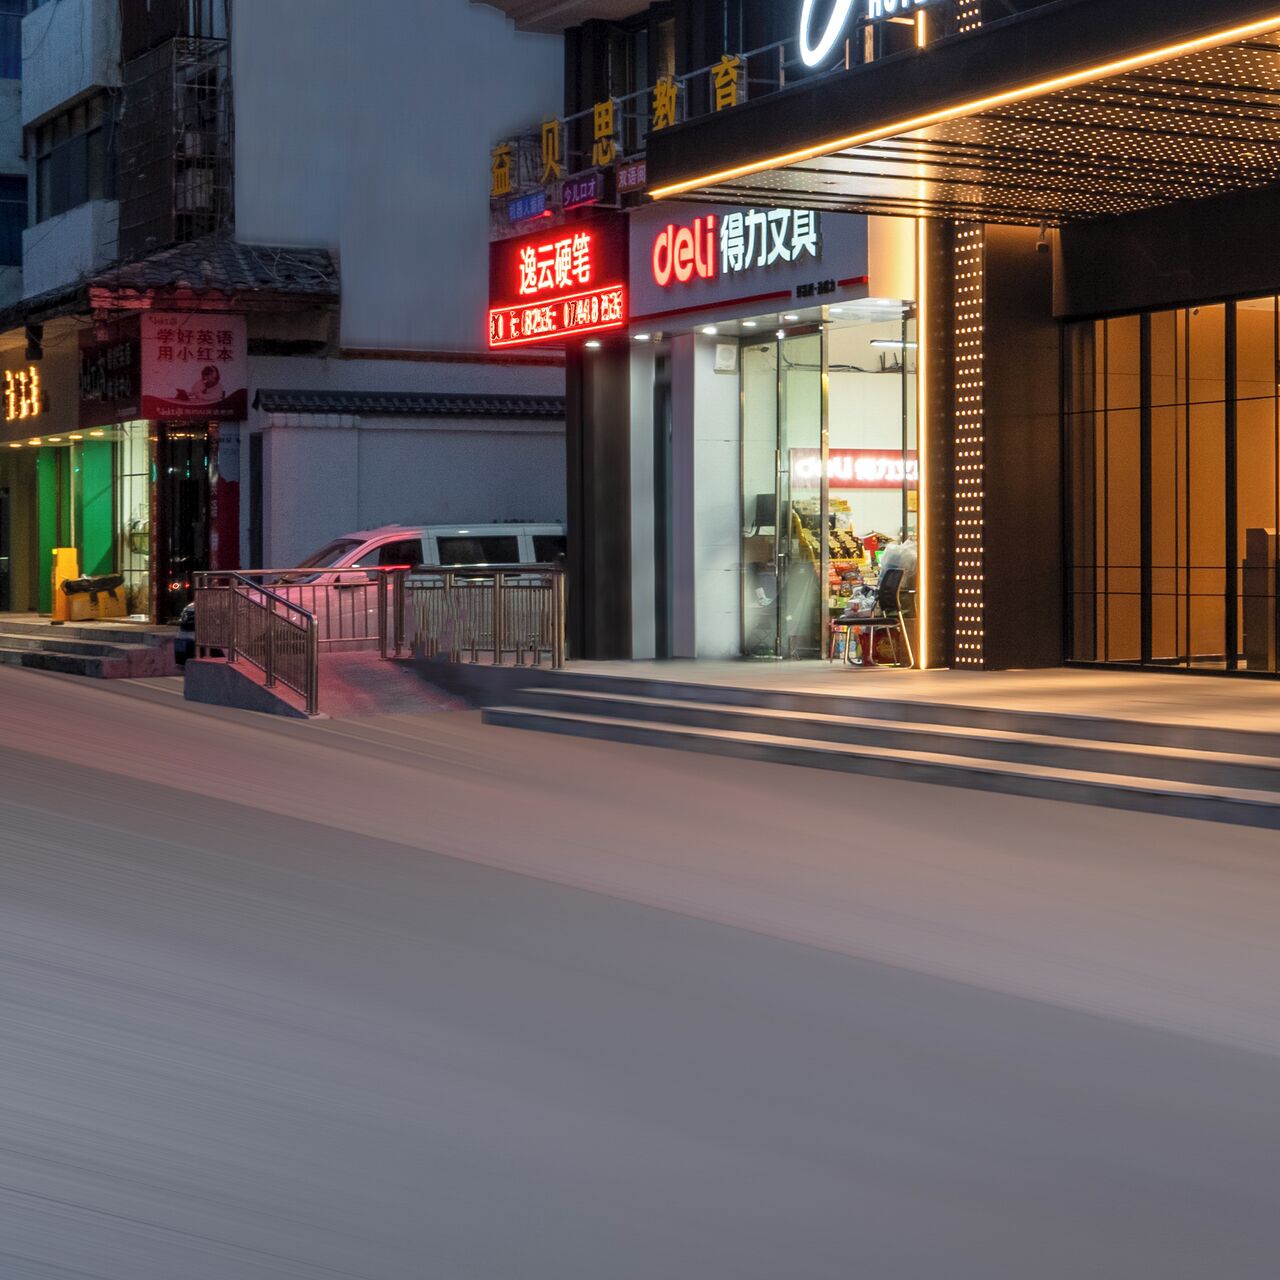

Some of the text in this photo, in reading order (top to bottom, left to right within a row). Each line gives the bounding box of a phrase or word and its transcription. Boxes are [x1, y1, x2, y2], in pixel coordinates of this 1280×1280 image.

[489, 54, 742, 197] 益贝思教育
[564, 179, 597, 205] 少儿口才
[519, 232, 591, 295] 逸云硬笔
[653, 214, 716, 287] deli
[720, 208, 818, 274] 得力文具
[157, 328, 234, 346] 学好英语
[157, 346, 234, 362] 用小红本
